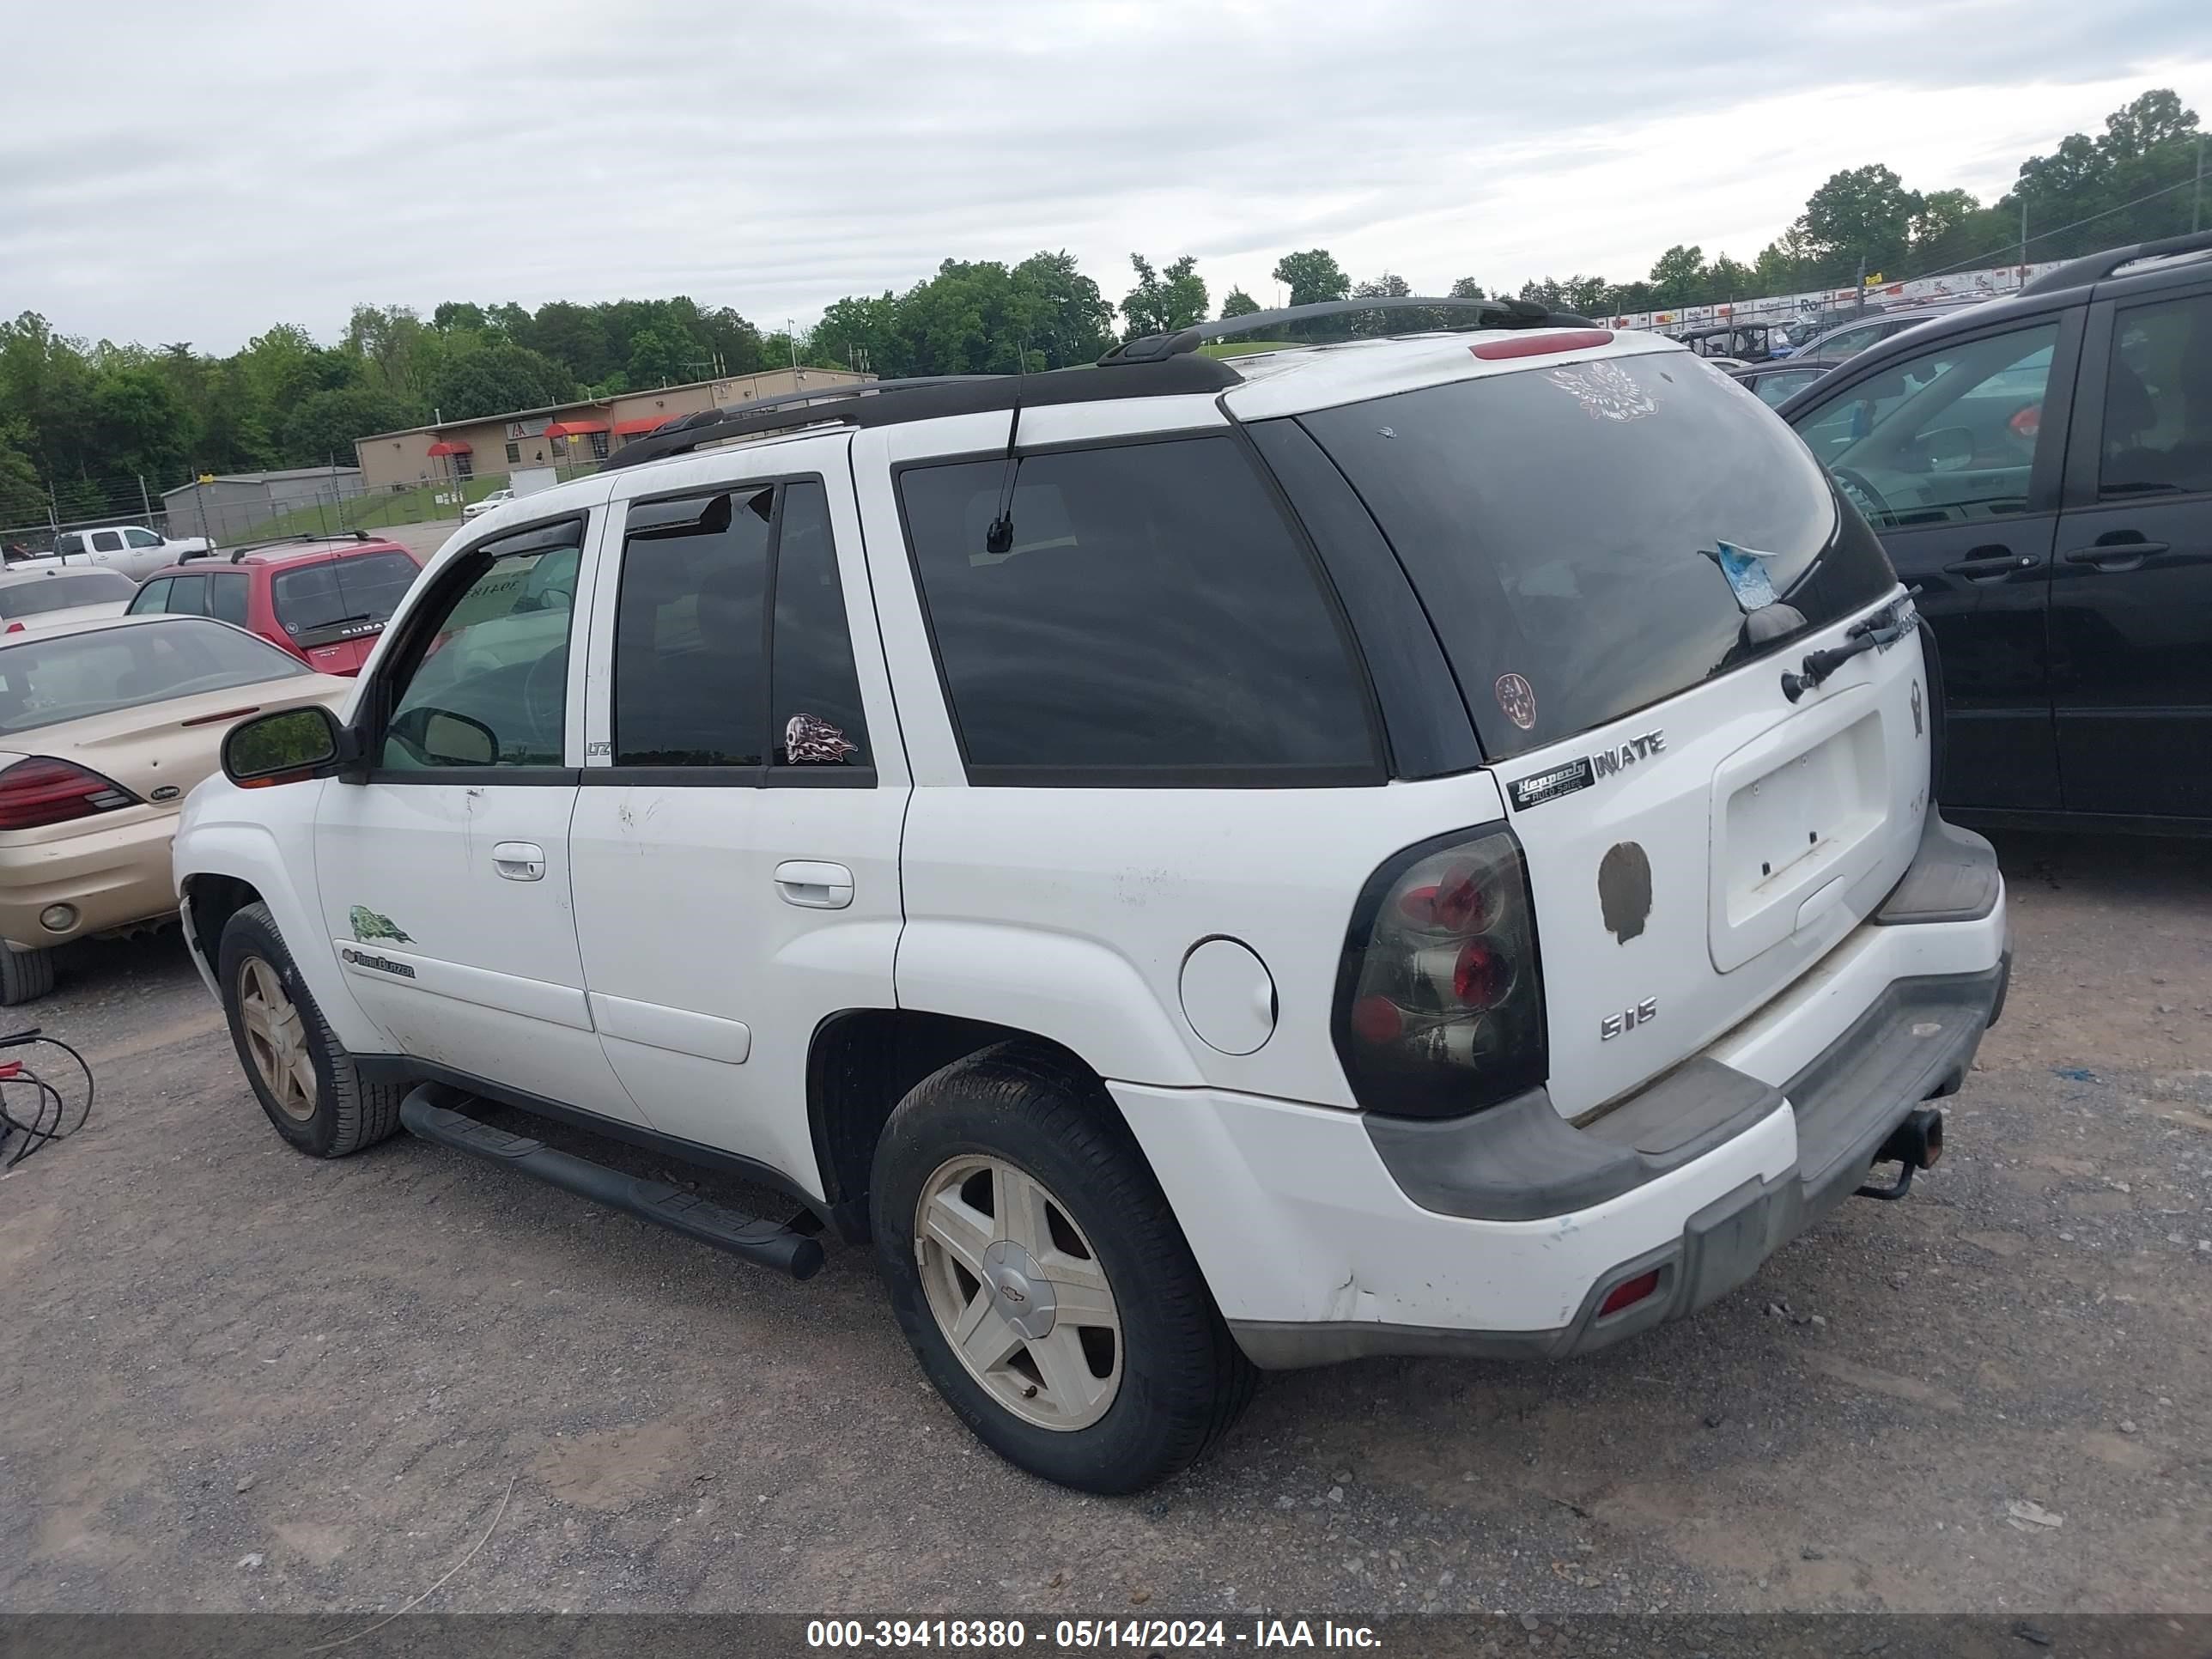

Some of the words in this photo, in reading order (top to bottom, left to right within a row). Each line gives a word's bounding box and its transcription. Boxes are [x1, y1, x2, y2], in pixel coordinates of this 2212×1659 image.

[587, 741, 611, 756] LTZ
[1593, 728, 1667, 778] NATE
[1517, 762, 1585, 796] Hepperly
